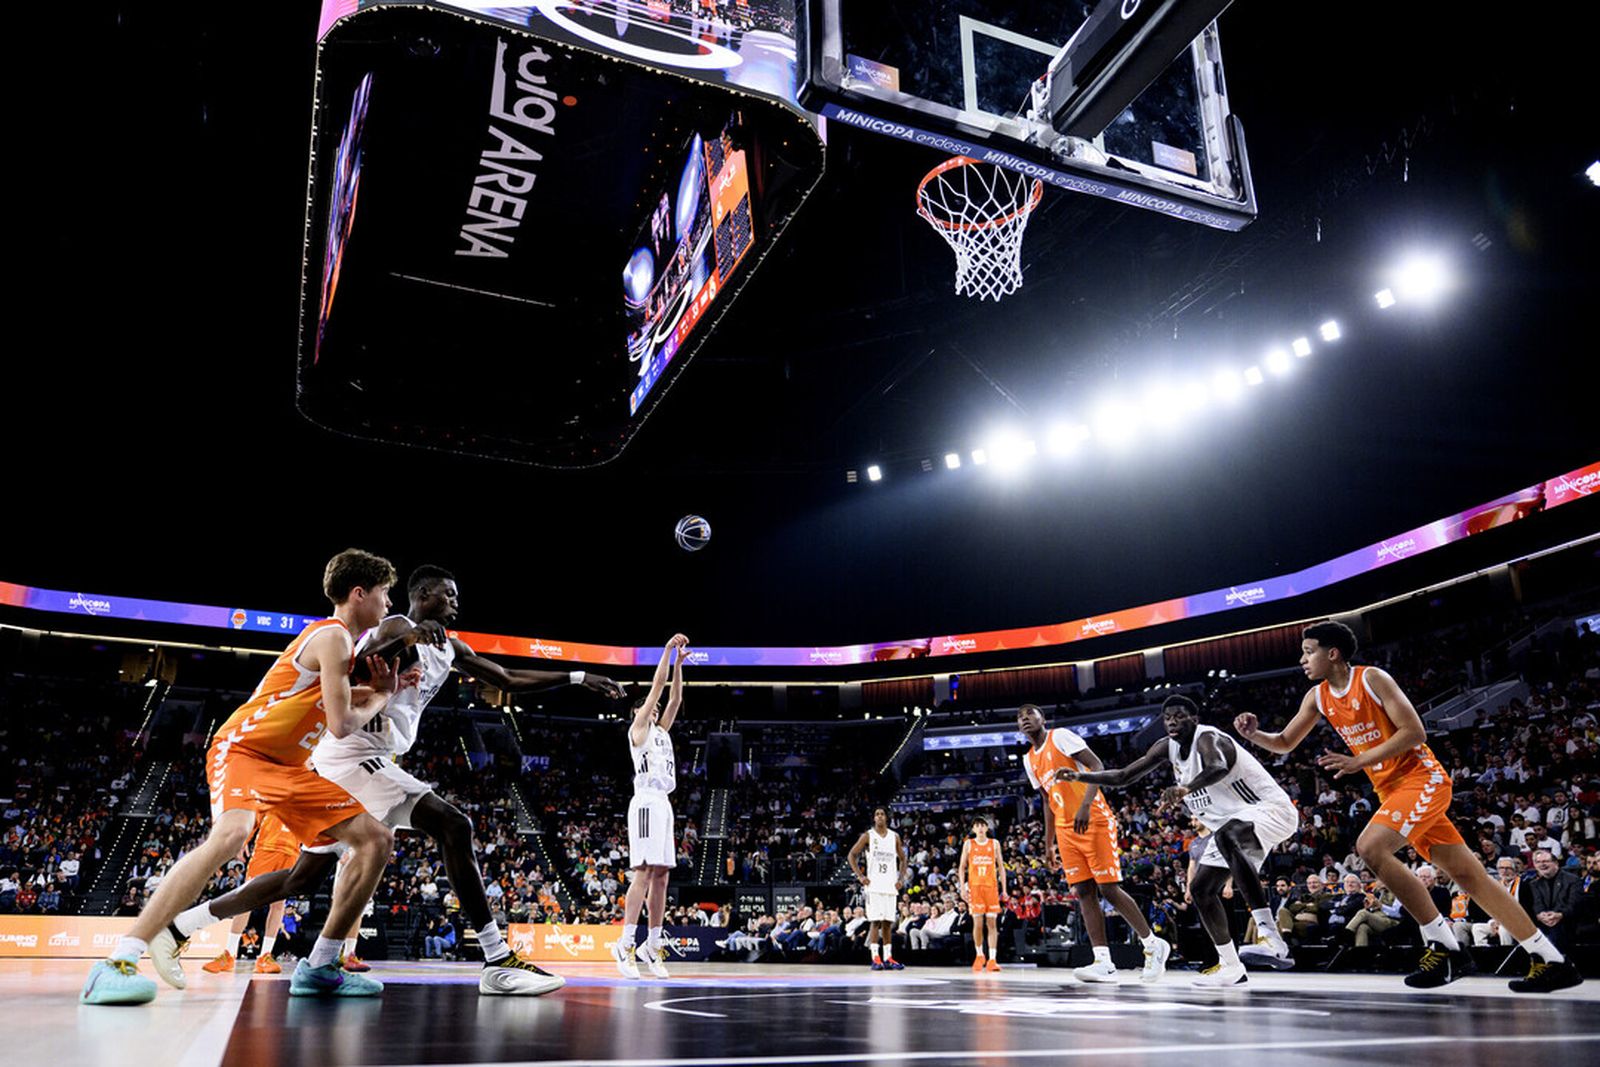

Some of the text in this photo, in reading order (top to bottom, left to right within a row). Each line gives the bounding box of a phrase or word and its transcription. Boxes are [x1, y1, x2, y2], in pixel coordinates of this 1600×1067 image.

[490, 36, 577, 135] oig
[836, 109, 1230, 226] MINICOPA endesa MINICOPA endesa MINICOPA endesa
[455, 125, 543, 257] ARENA
[280, 616, 294, 629] 31
[298, 721, 323, 750] 2
[1343, 729, 1381, 746] fuerzo
[1190, 795, 1213, 810] ETTER
[740, 904, 765, 912] SALDA
[658, 937, 700, 947] INICOPA
